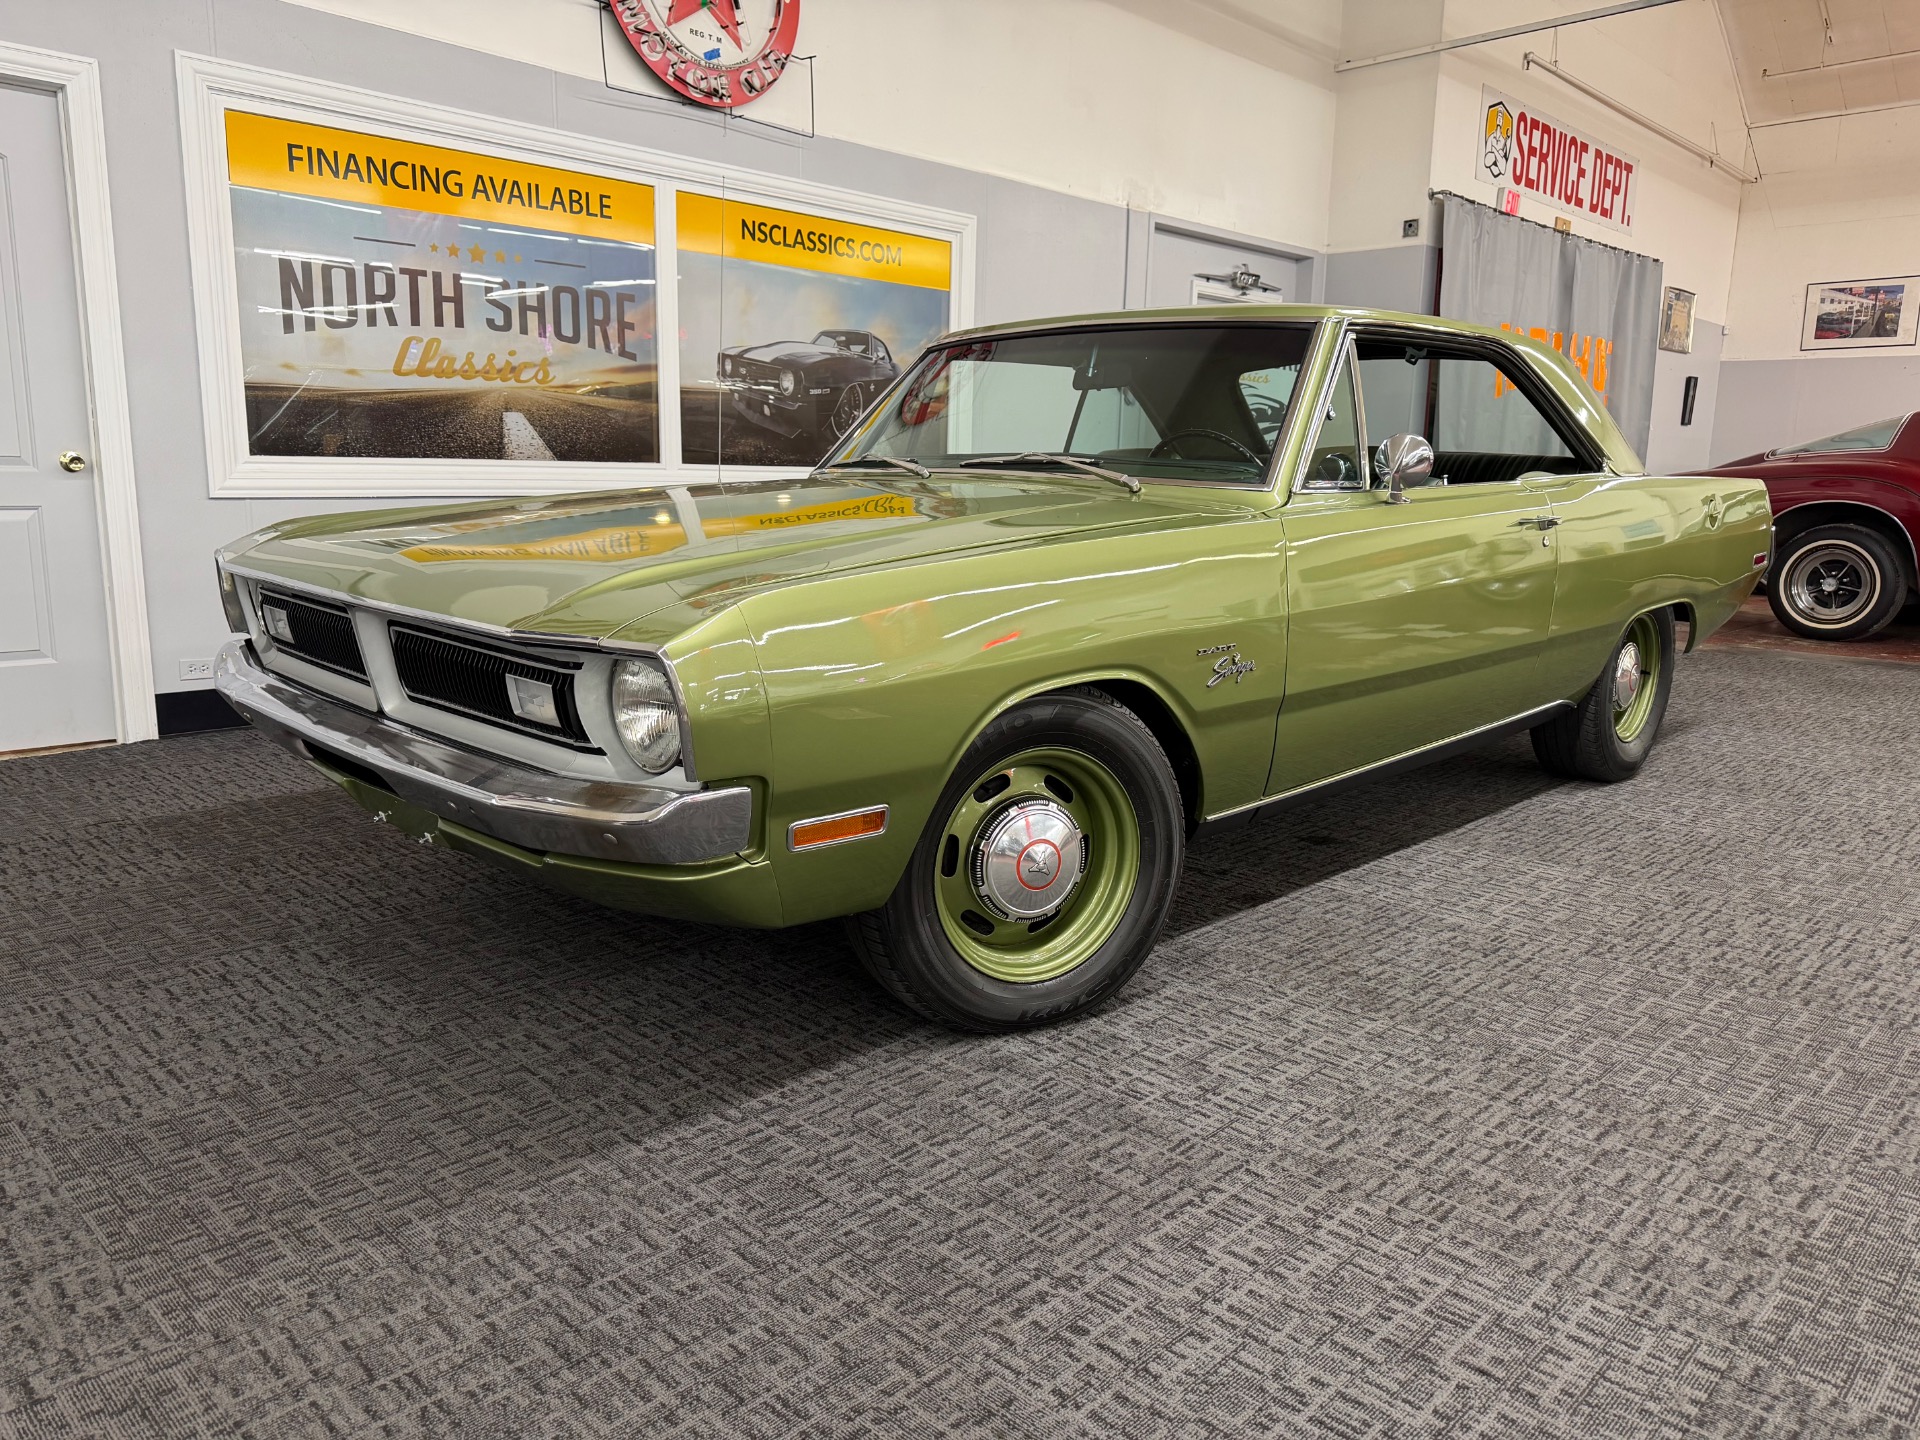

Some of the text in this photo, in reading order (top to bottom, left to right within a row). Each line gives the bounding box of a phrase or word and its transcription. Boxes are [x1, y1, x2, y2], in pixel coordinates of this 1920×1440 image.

[690, 55, 702, 65] THE
[286, 142, 613, 220] FINANCING AVAILABLE
[1512, 111, 1634, 227] SERVICE DEPT.
[741, 218, 902, 266] NSCLASSICS.COM
[278, 255, 638, 362] NORTH SHORE
[392, 335, 556, 386] Classics
[1197, 643, 1237, 656] DART
